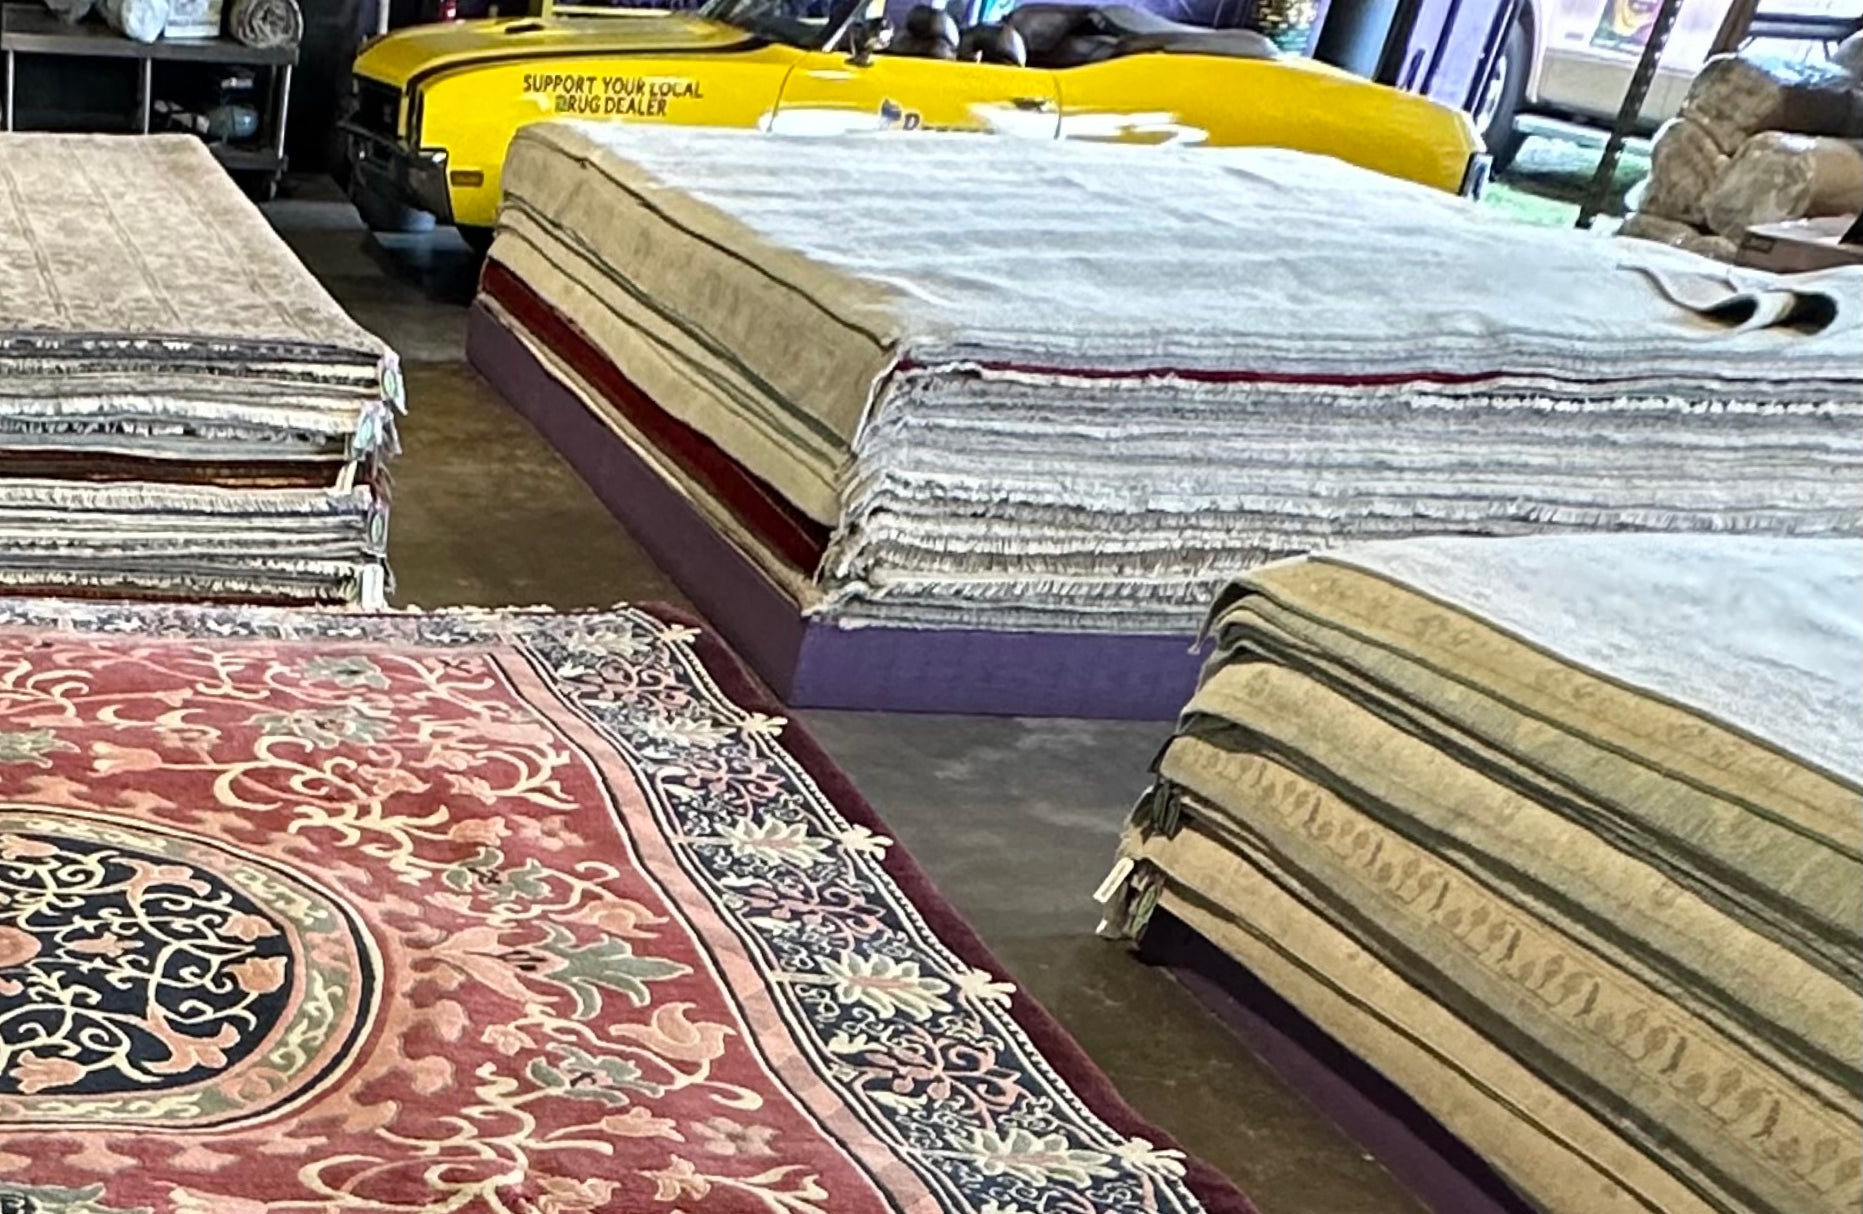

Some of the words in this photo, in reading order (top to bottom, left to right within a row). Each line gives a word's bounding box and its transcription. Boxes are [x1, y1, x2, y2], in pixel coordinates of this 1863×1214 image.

[523, 74, 597, 95] SUPPORT
[602, 77, 646, 96] YOUR
[649, 81, 703, 98] LOCAL
[555, 94, 601, 113] DRUG
[604, 96, 668, 116] DEALER
